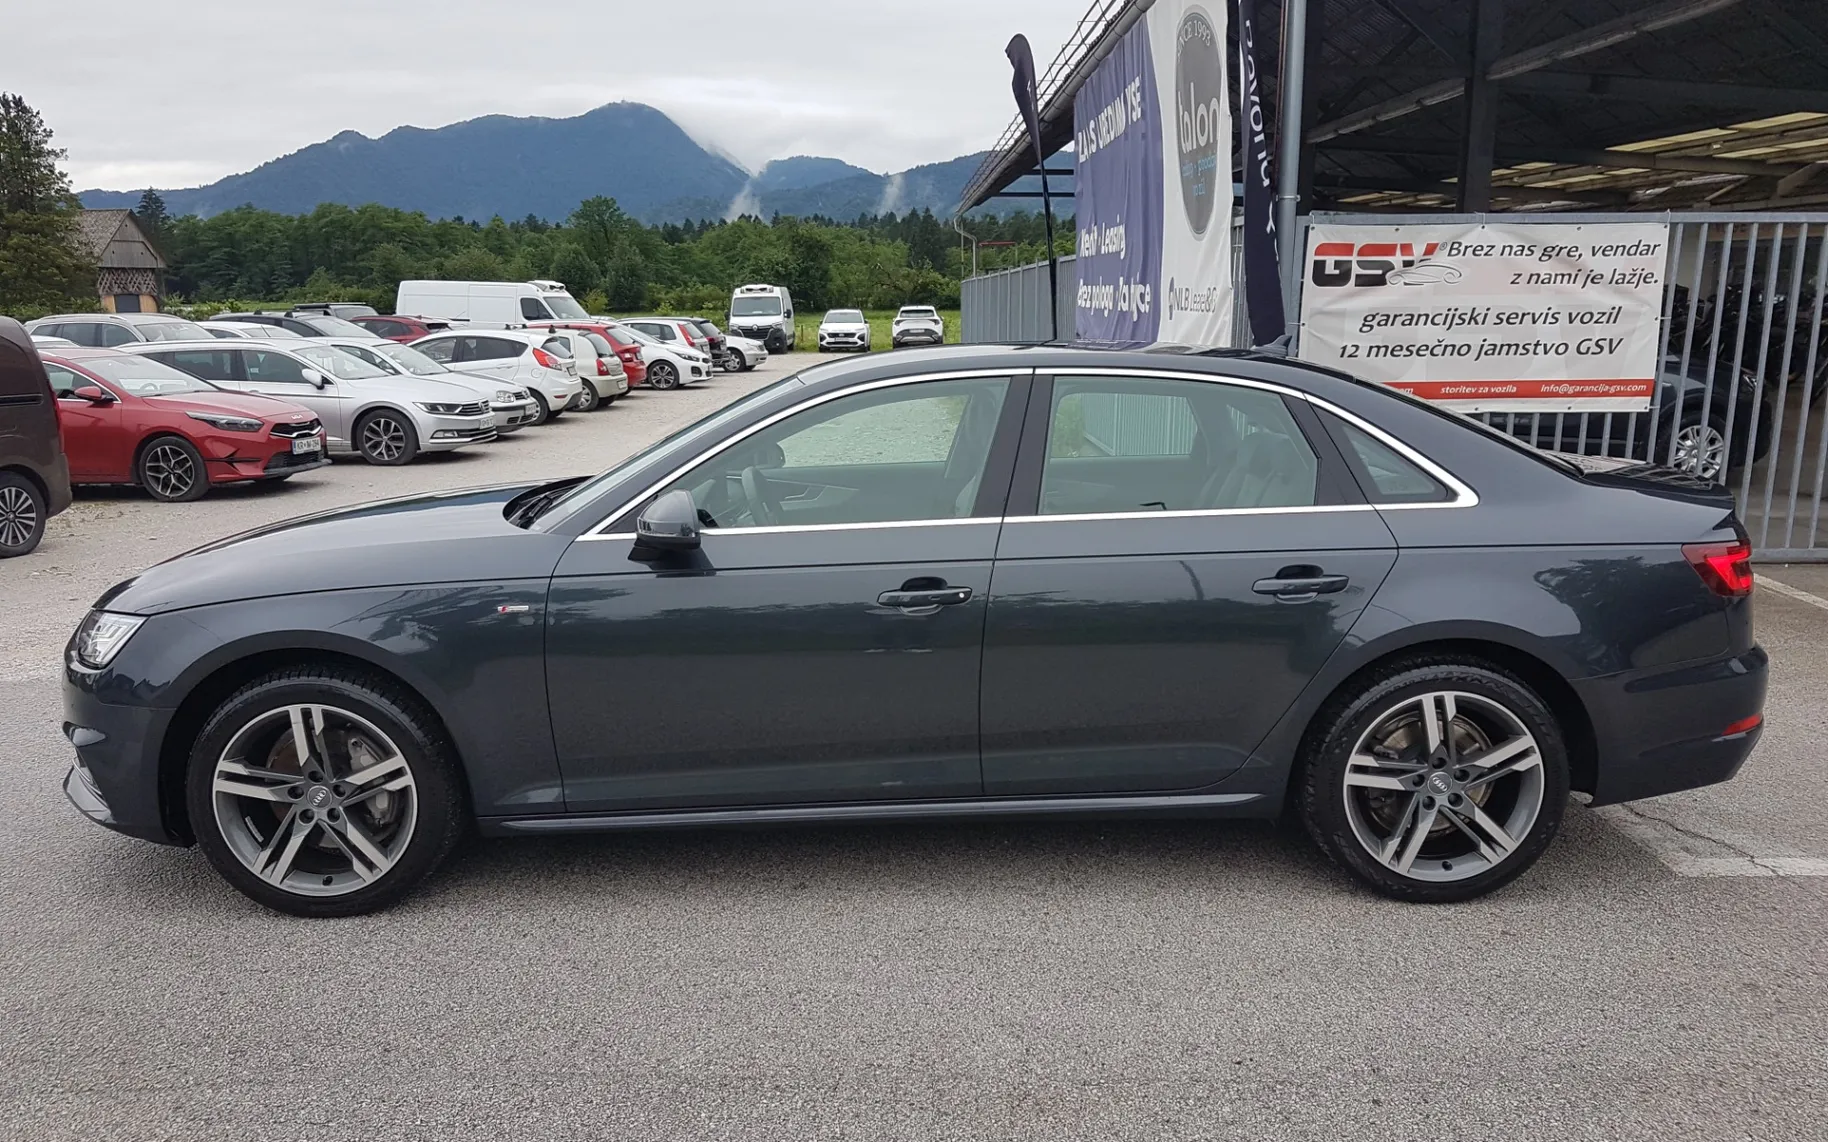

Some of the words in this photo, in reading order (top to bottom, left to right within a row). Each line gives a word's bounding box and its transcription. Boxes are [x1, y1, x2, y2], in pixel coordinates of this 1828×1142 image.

[1447, 241, 1495, 257] Brez
[1500, 244, 1536, 257] nas
[1538, 244, 1583, 262] gre,
[1591, 239, 1661, 257] vendar
[1510, 273, 1522, 285] z
[1526, 269, 1582, 285] nami
[1581, 269, 1604, 289] je
[1608, 267, 1659, 289] lažje.
[1358, 307, 1490, 333] garancijski
[1493, 306, 1560, 326] servis
[1567, 306, 1622, 325] vozil
[1339, 344, 1360, 358] 12
[1366, 339, 1472, 358] mesečno
[1474, 338, 1569, 361] jamstvo
[1575, 337, 1624, 355] GSV
[1440, 384, 1477, 394] storitev
[1479, 386, 1489, 394] za
[1491, 384, 1517, 394] vozila
